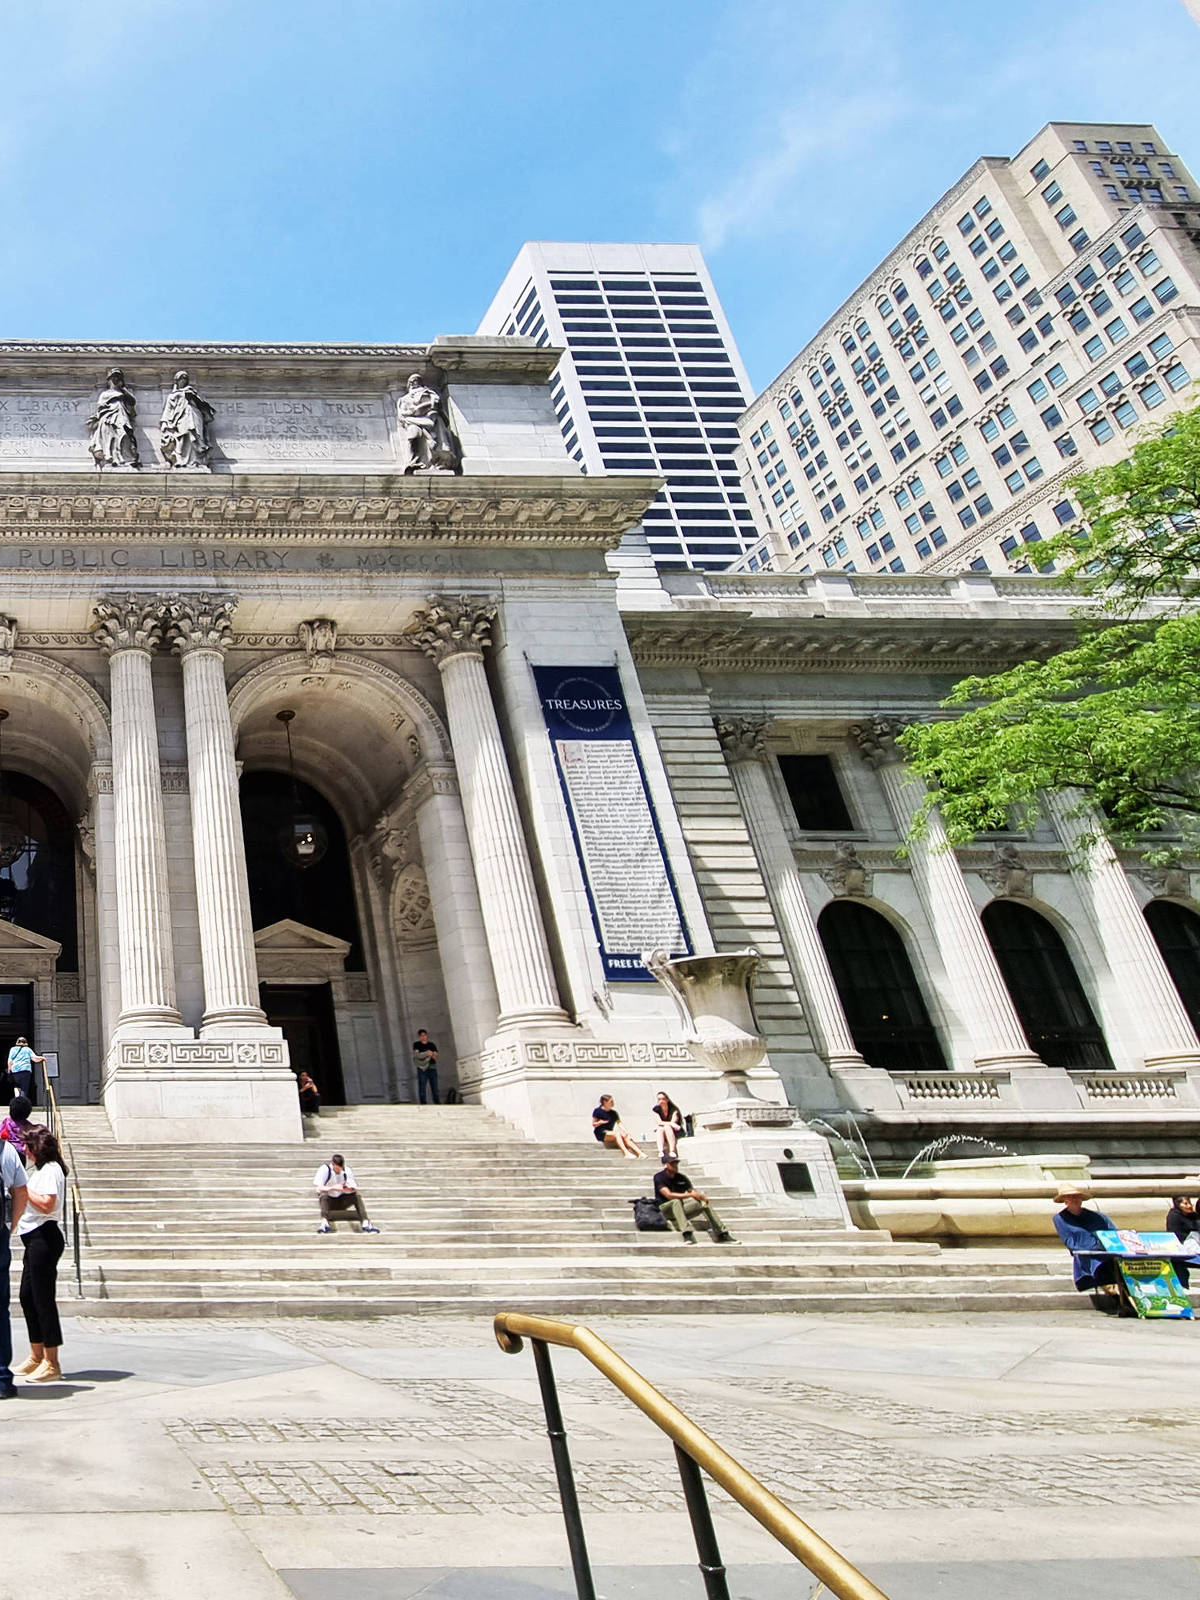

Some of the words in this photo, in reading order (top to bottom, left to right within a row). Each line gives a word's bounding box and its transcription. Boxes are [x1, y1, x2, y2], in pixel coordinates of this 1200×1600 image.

[17, 400, 82, 412] LIBRARY
[215, 402, 246, 414] THE
[257, 402, 313, 414] TILDEN
[327, 403, 374, 415] TRUST
[5, 423, 48, 432] LENOX
[18, 549, 131, 568] PUBLIC
[160, 550, 289, 569] LIBRARY
[545, 698, 623, 711] TREASURES
[608, 959, 633, 969] FREE
